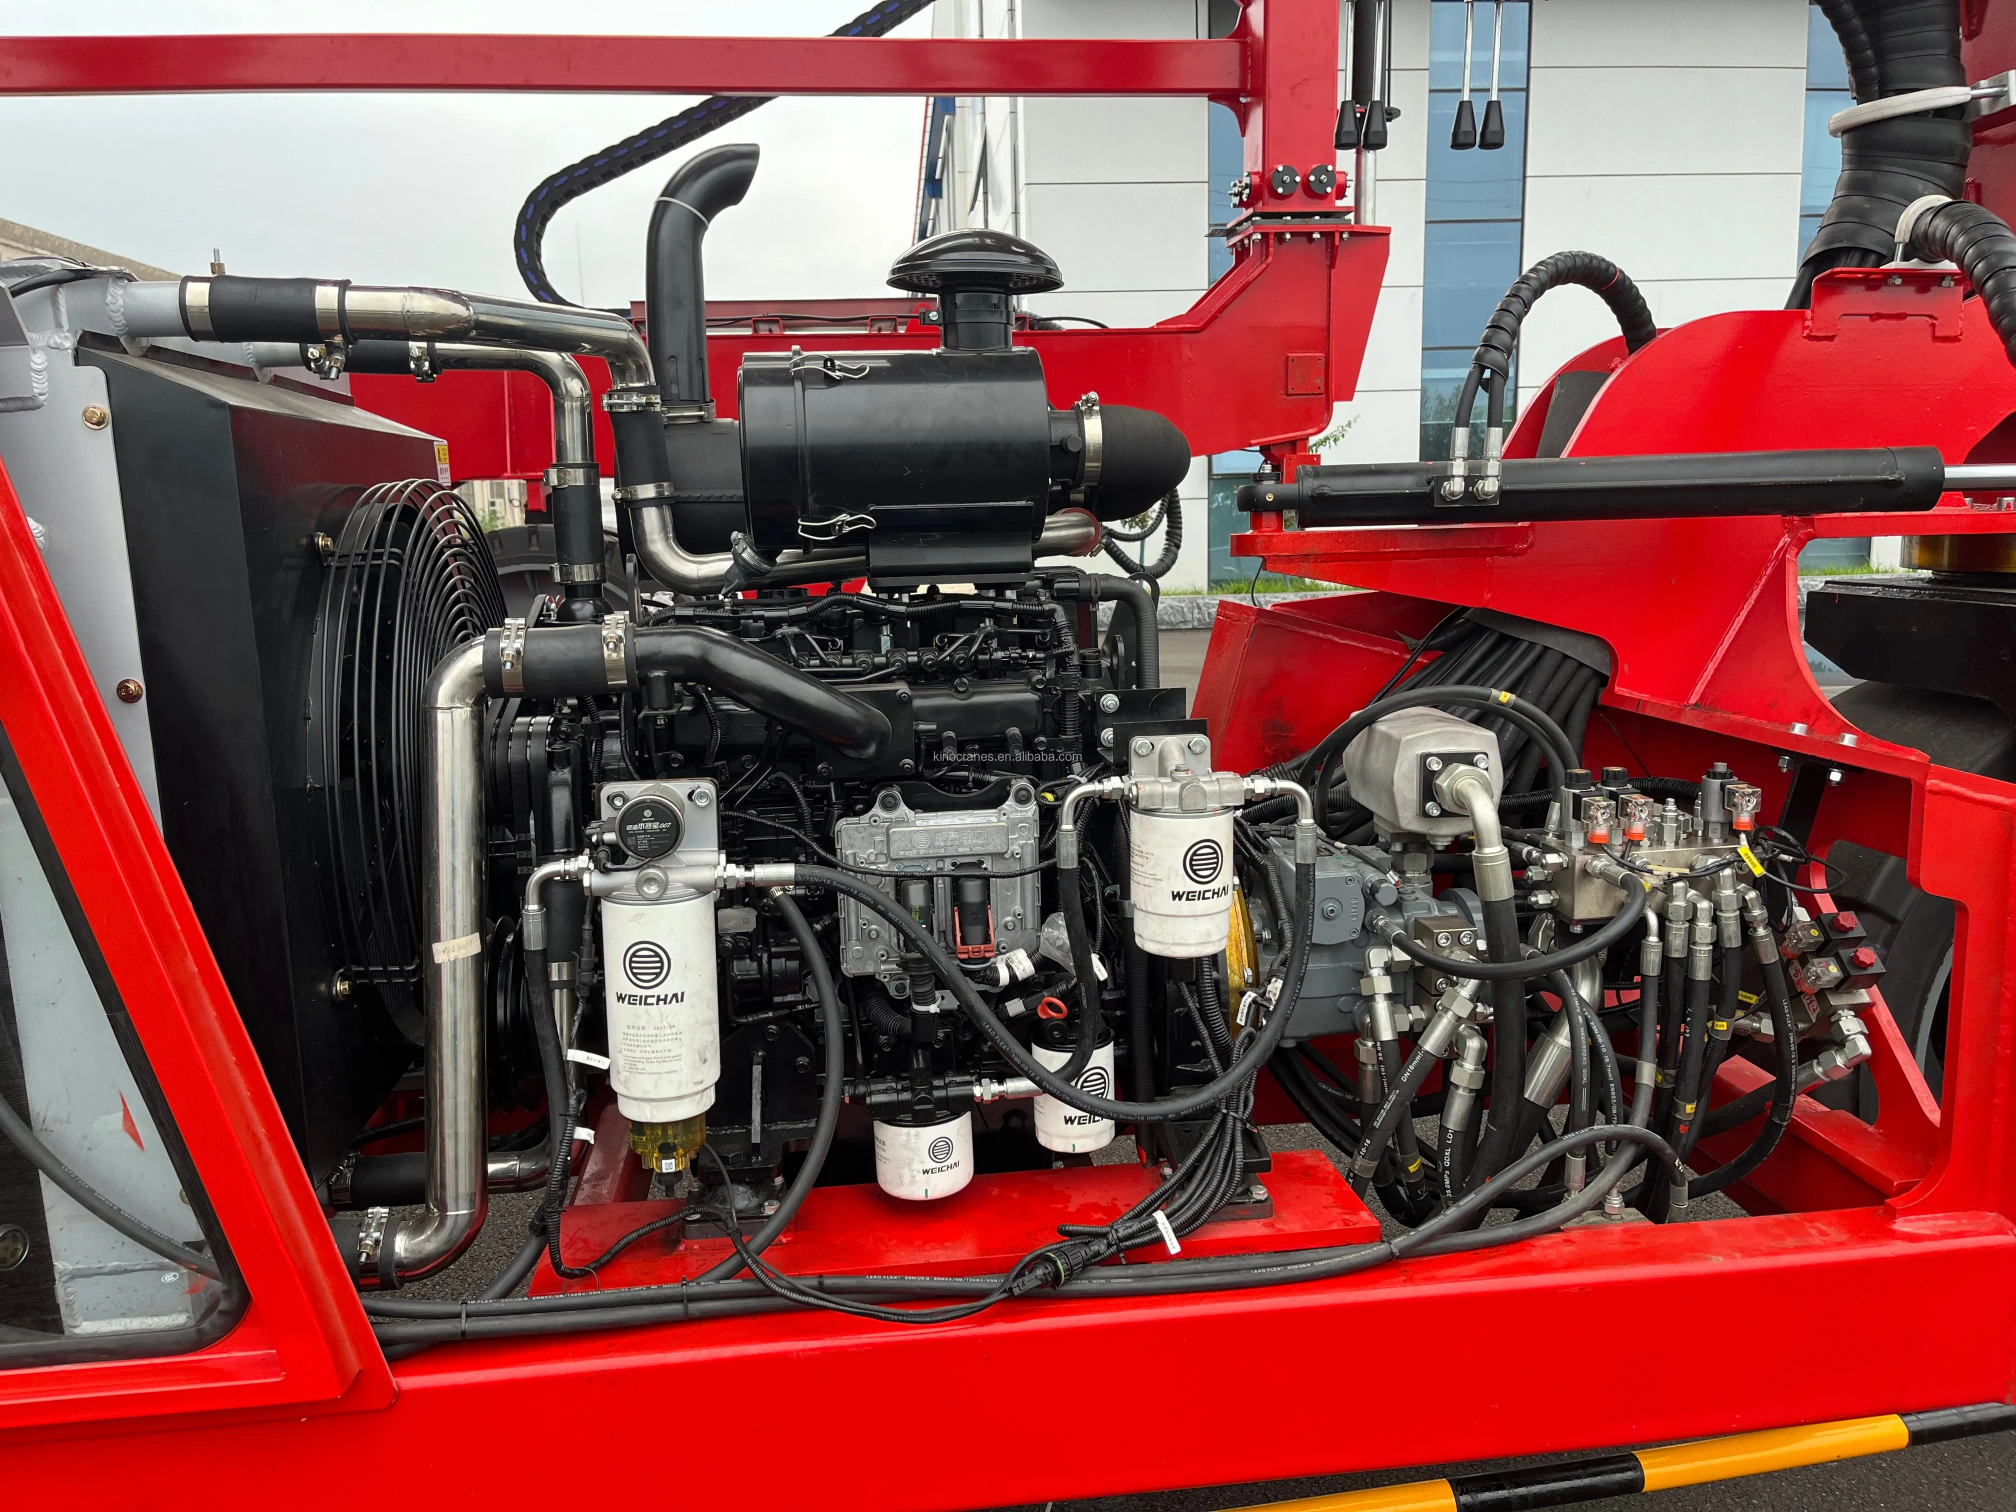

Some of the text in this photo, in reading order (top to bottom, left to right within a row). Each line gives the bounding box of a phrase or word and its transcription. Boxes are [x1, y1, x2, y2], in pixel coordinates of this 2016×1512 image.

[1171, 883, 1229, 901] WEICHAI
[616, 991, 685, 1006] WEICHAI
[1443, 1147, 1451, 1167] QDXL
[922, 1160, 960, 1175] WEICHAI
